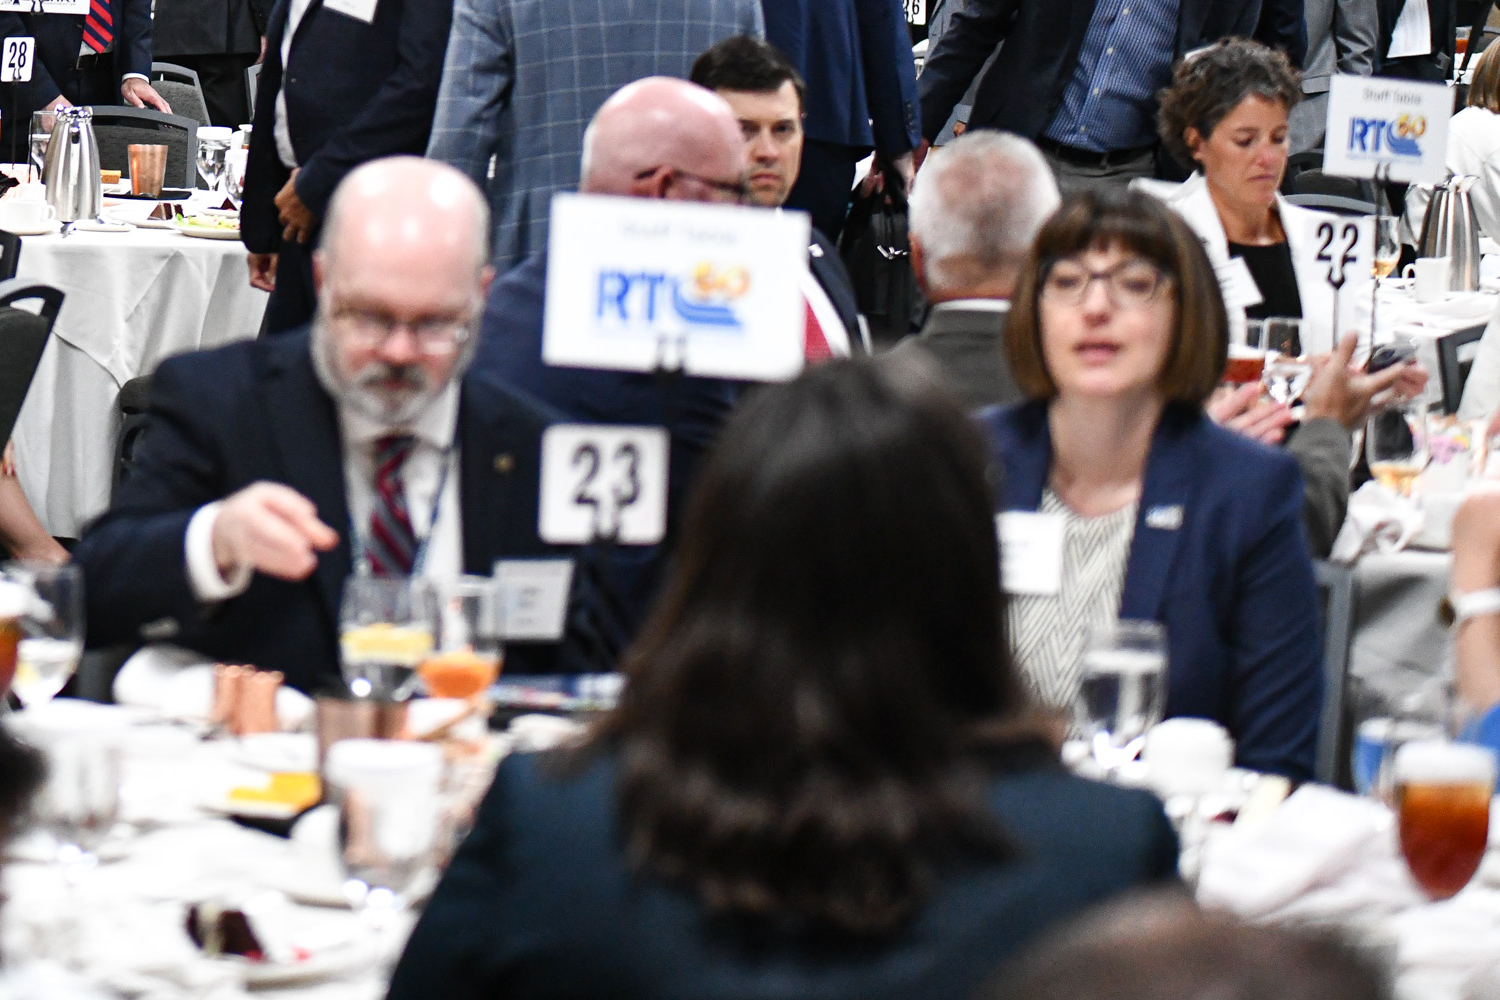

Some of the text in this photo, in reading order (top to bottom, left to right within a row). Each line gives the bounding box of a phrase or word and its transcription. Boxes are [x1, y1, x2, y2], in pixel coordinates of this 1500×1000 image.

[8, 41, 27, 68] 28
[1316, 222, 1359, 263] 22
[572, 442, 641, 505] 23
